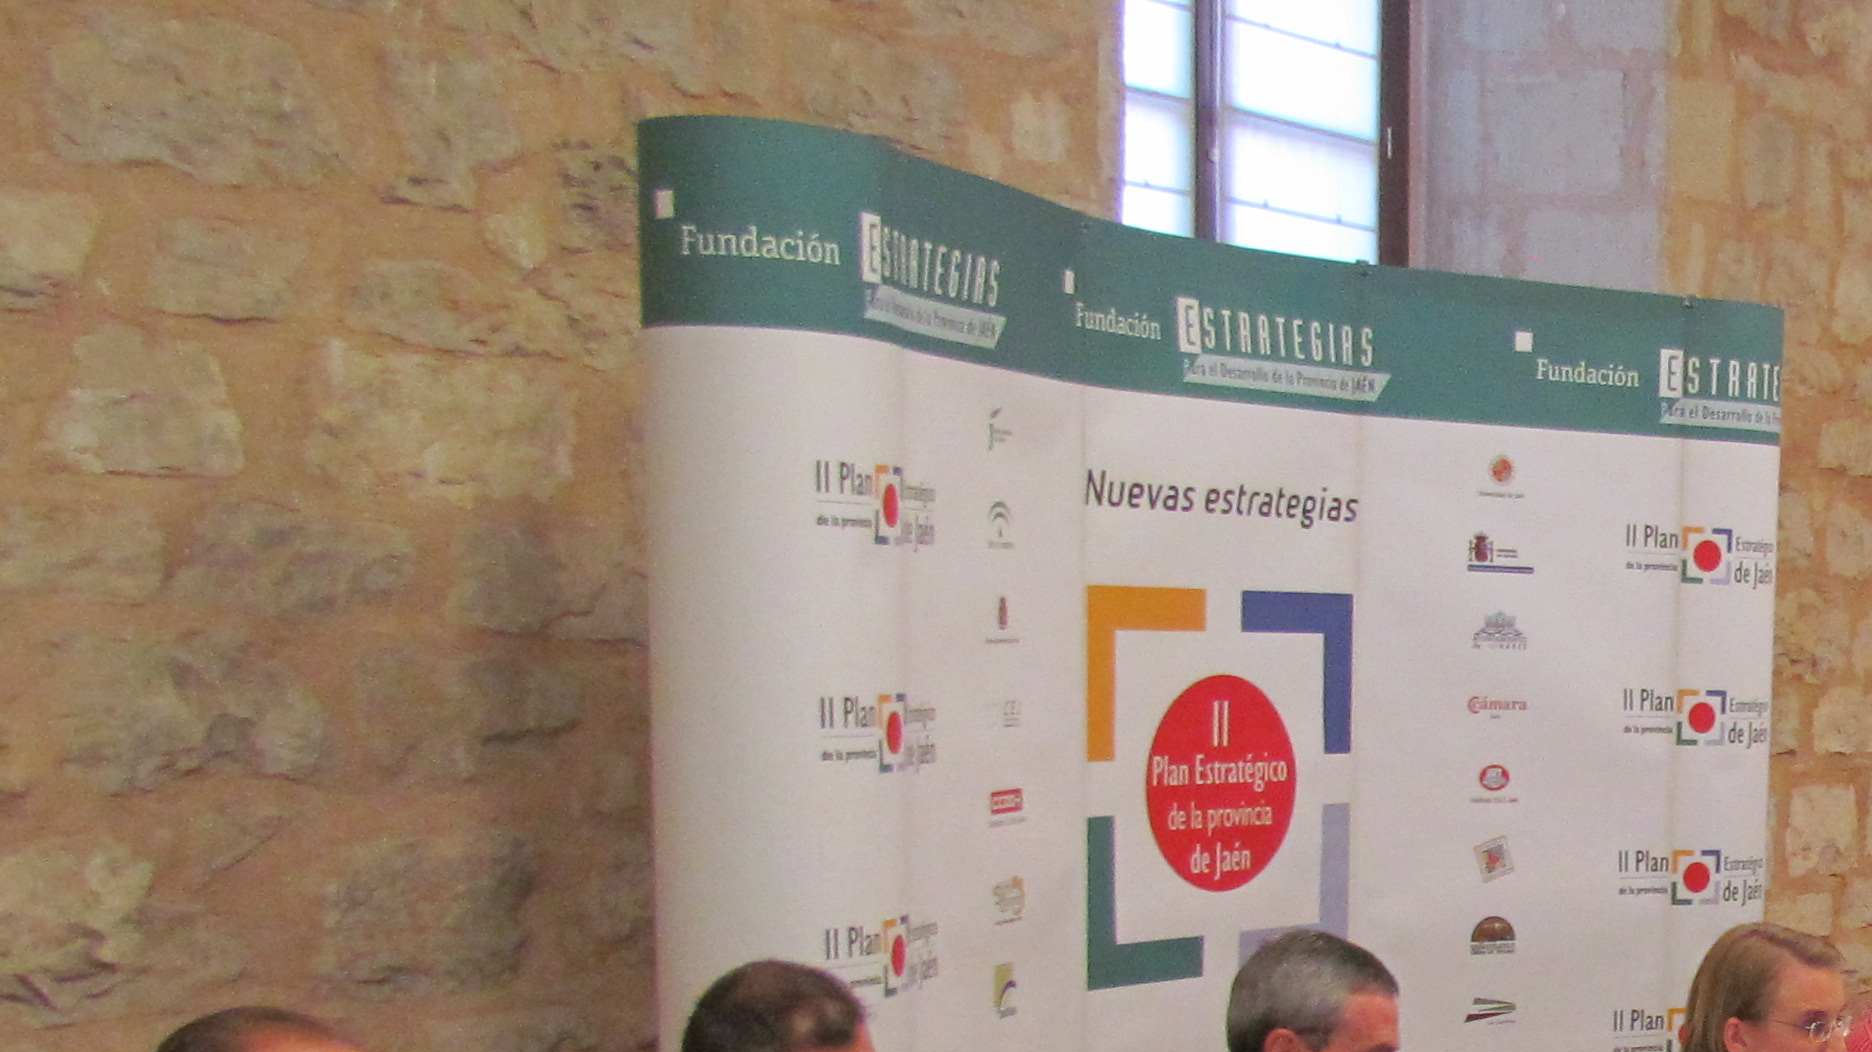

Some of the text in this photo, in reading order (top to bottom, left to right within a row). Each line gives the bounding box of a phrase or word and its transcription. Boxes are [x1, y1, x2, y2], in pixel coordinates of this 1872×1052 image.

[681, 221, 1000, 308] Fundación ESTRATEGIAS
[1075, 302, 1374, 367] Fundación ESTRATEGIAS
[1536, 358, 1640, 387] Fundación
[815, 460, 830, 494] II
[1085, 468, 1359, 529] Nuevas estrategias
[1626, 524, 1637, 548] II
[1644, 524, 1679, 549] Plan
[1734, 560, 1750, 584] de
[820, 696, 834, 729] II
[1623, 688, 1634, 711] II
[1640, 688, 1674, 711] Plan
[1213, 699, 1230, 748] II
[1728, 721, 1745, 744] de
[1152, 751, 1288, 793] Plan Estratégico
[1168, 799, 1273, 837] de la provincia
[1190, 841, 1251, 881] de Jaén
[1618, 850, 1629, 872] II
[1635, 850, 1669, 872] Plan
[1722, 879, 1739, 902] de
[825, 928, 839, 961] II
[1613, 1009, 1665, 1032] II Plan
